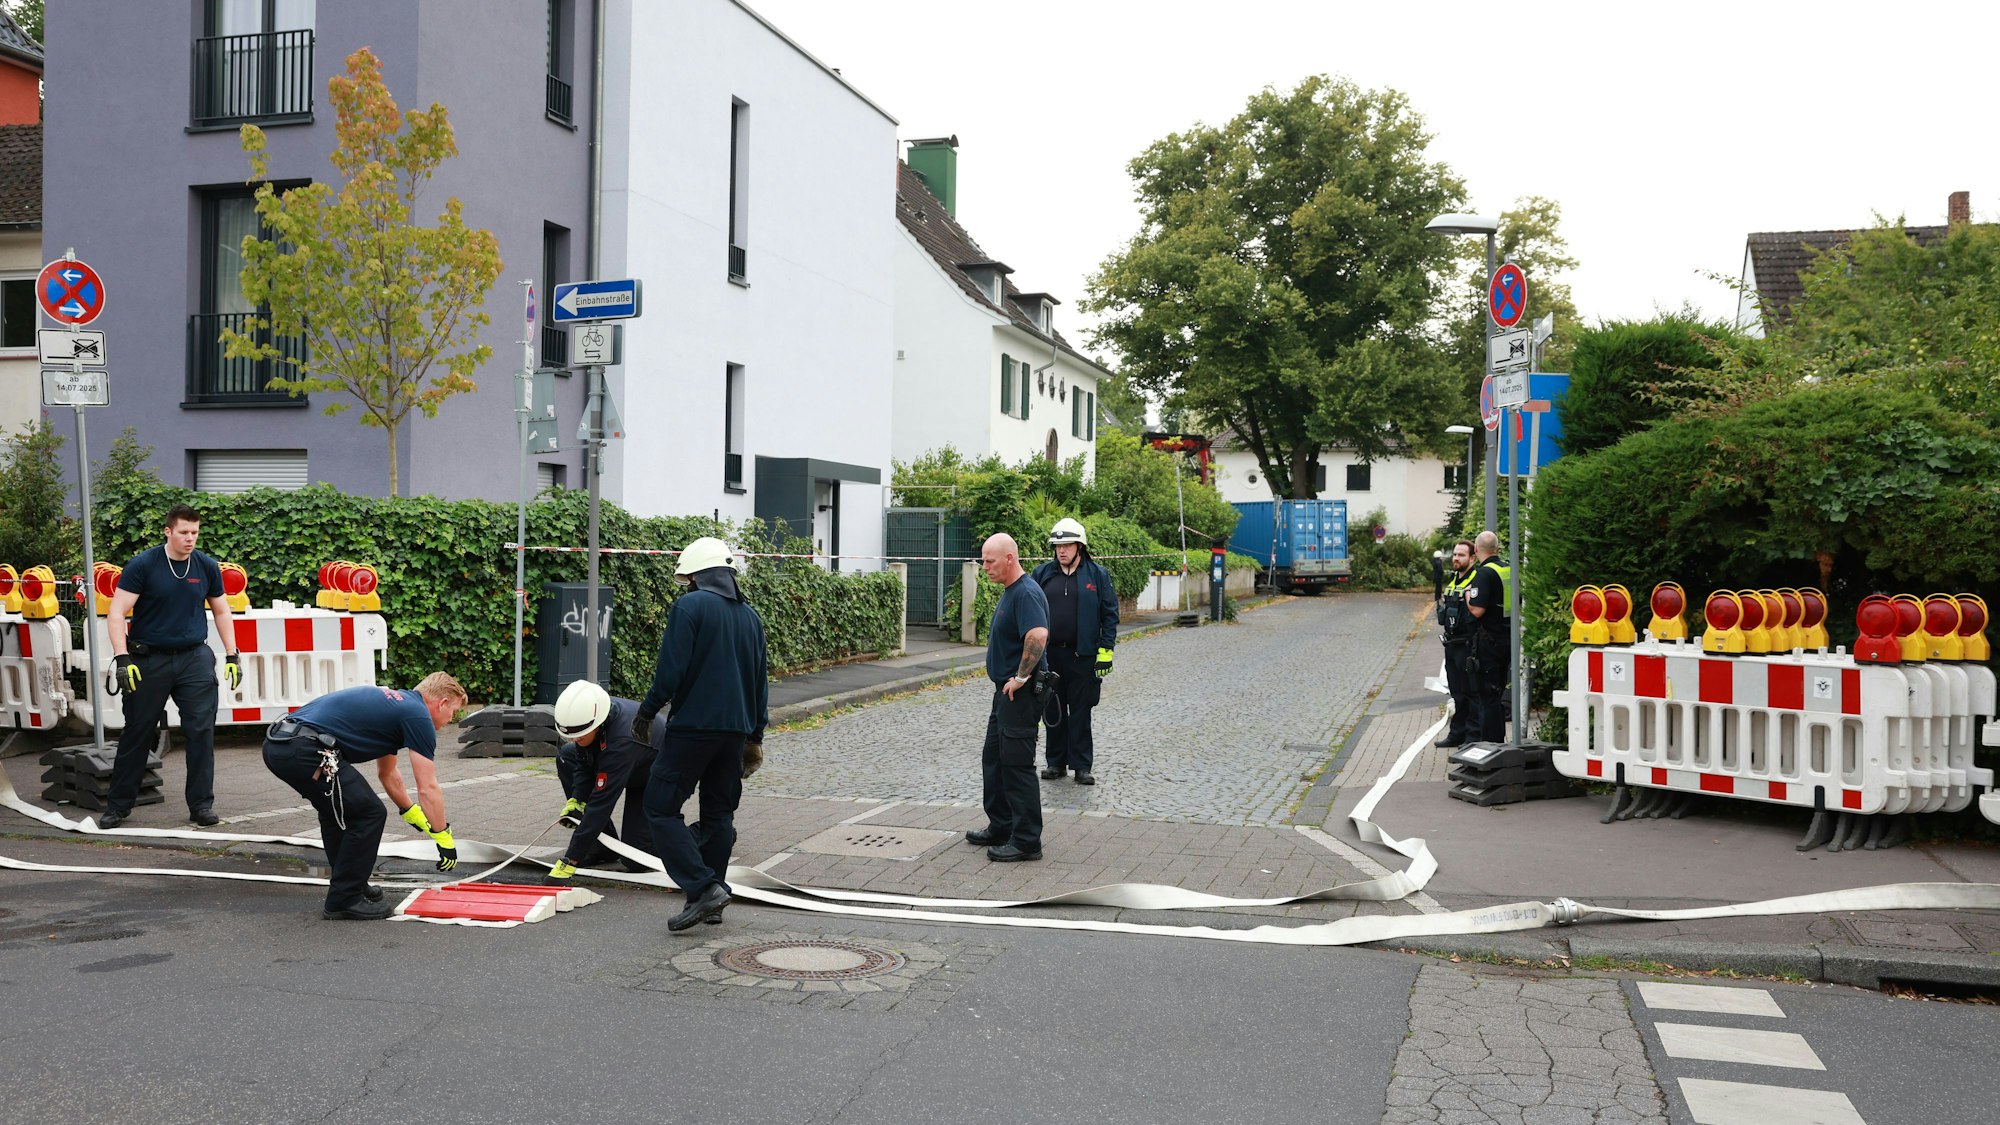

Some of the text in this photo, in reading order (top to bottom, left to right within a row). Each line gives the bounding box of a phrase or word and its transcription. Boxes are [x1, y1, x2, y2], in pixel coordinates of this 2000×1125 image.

[575, 293, 630, 305] Einbahnstraße
[69, 375, 79, 383] ab
[56, 384, 97, 392] 14.07.2025
